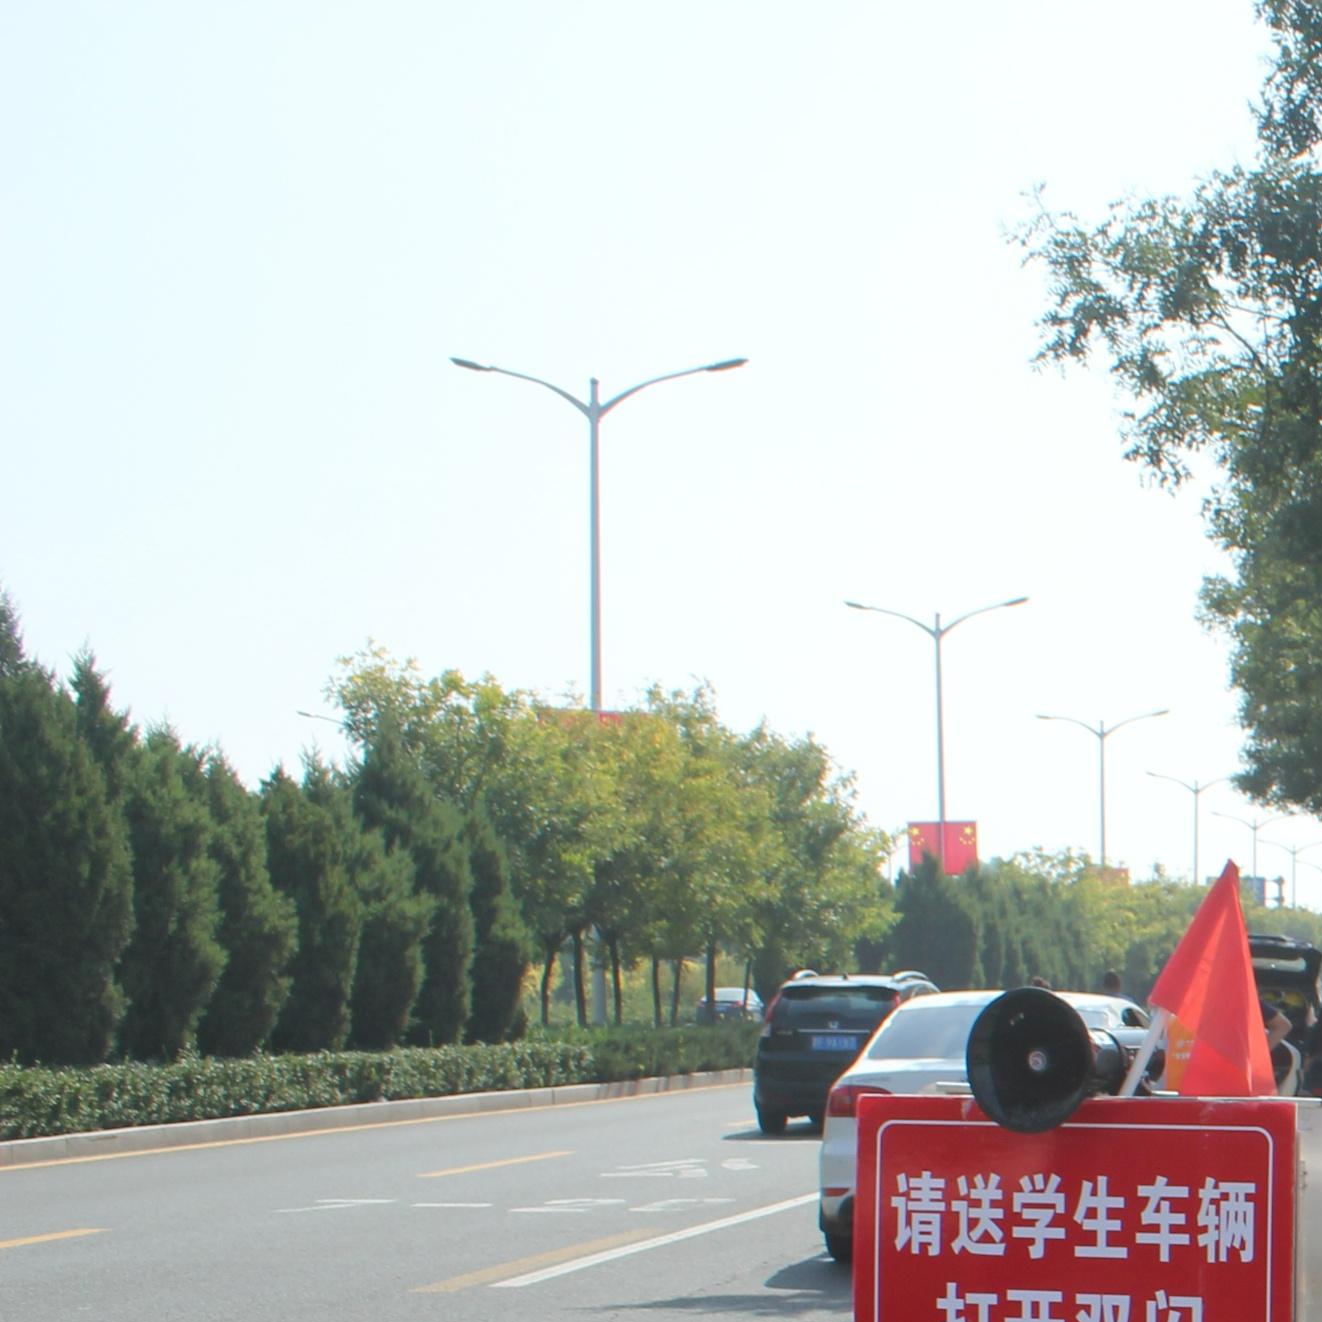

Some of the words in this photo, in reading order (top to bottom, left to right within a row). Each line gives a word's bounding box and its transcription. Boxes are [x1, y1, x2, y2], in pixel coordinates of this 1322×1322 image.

[891, 1170, 1256, 1264] 请送学生车辆
